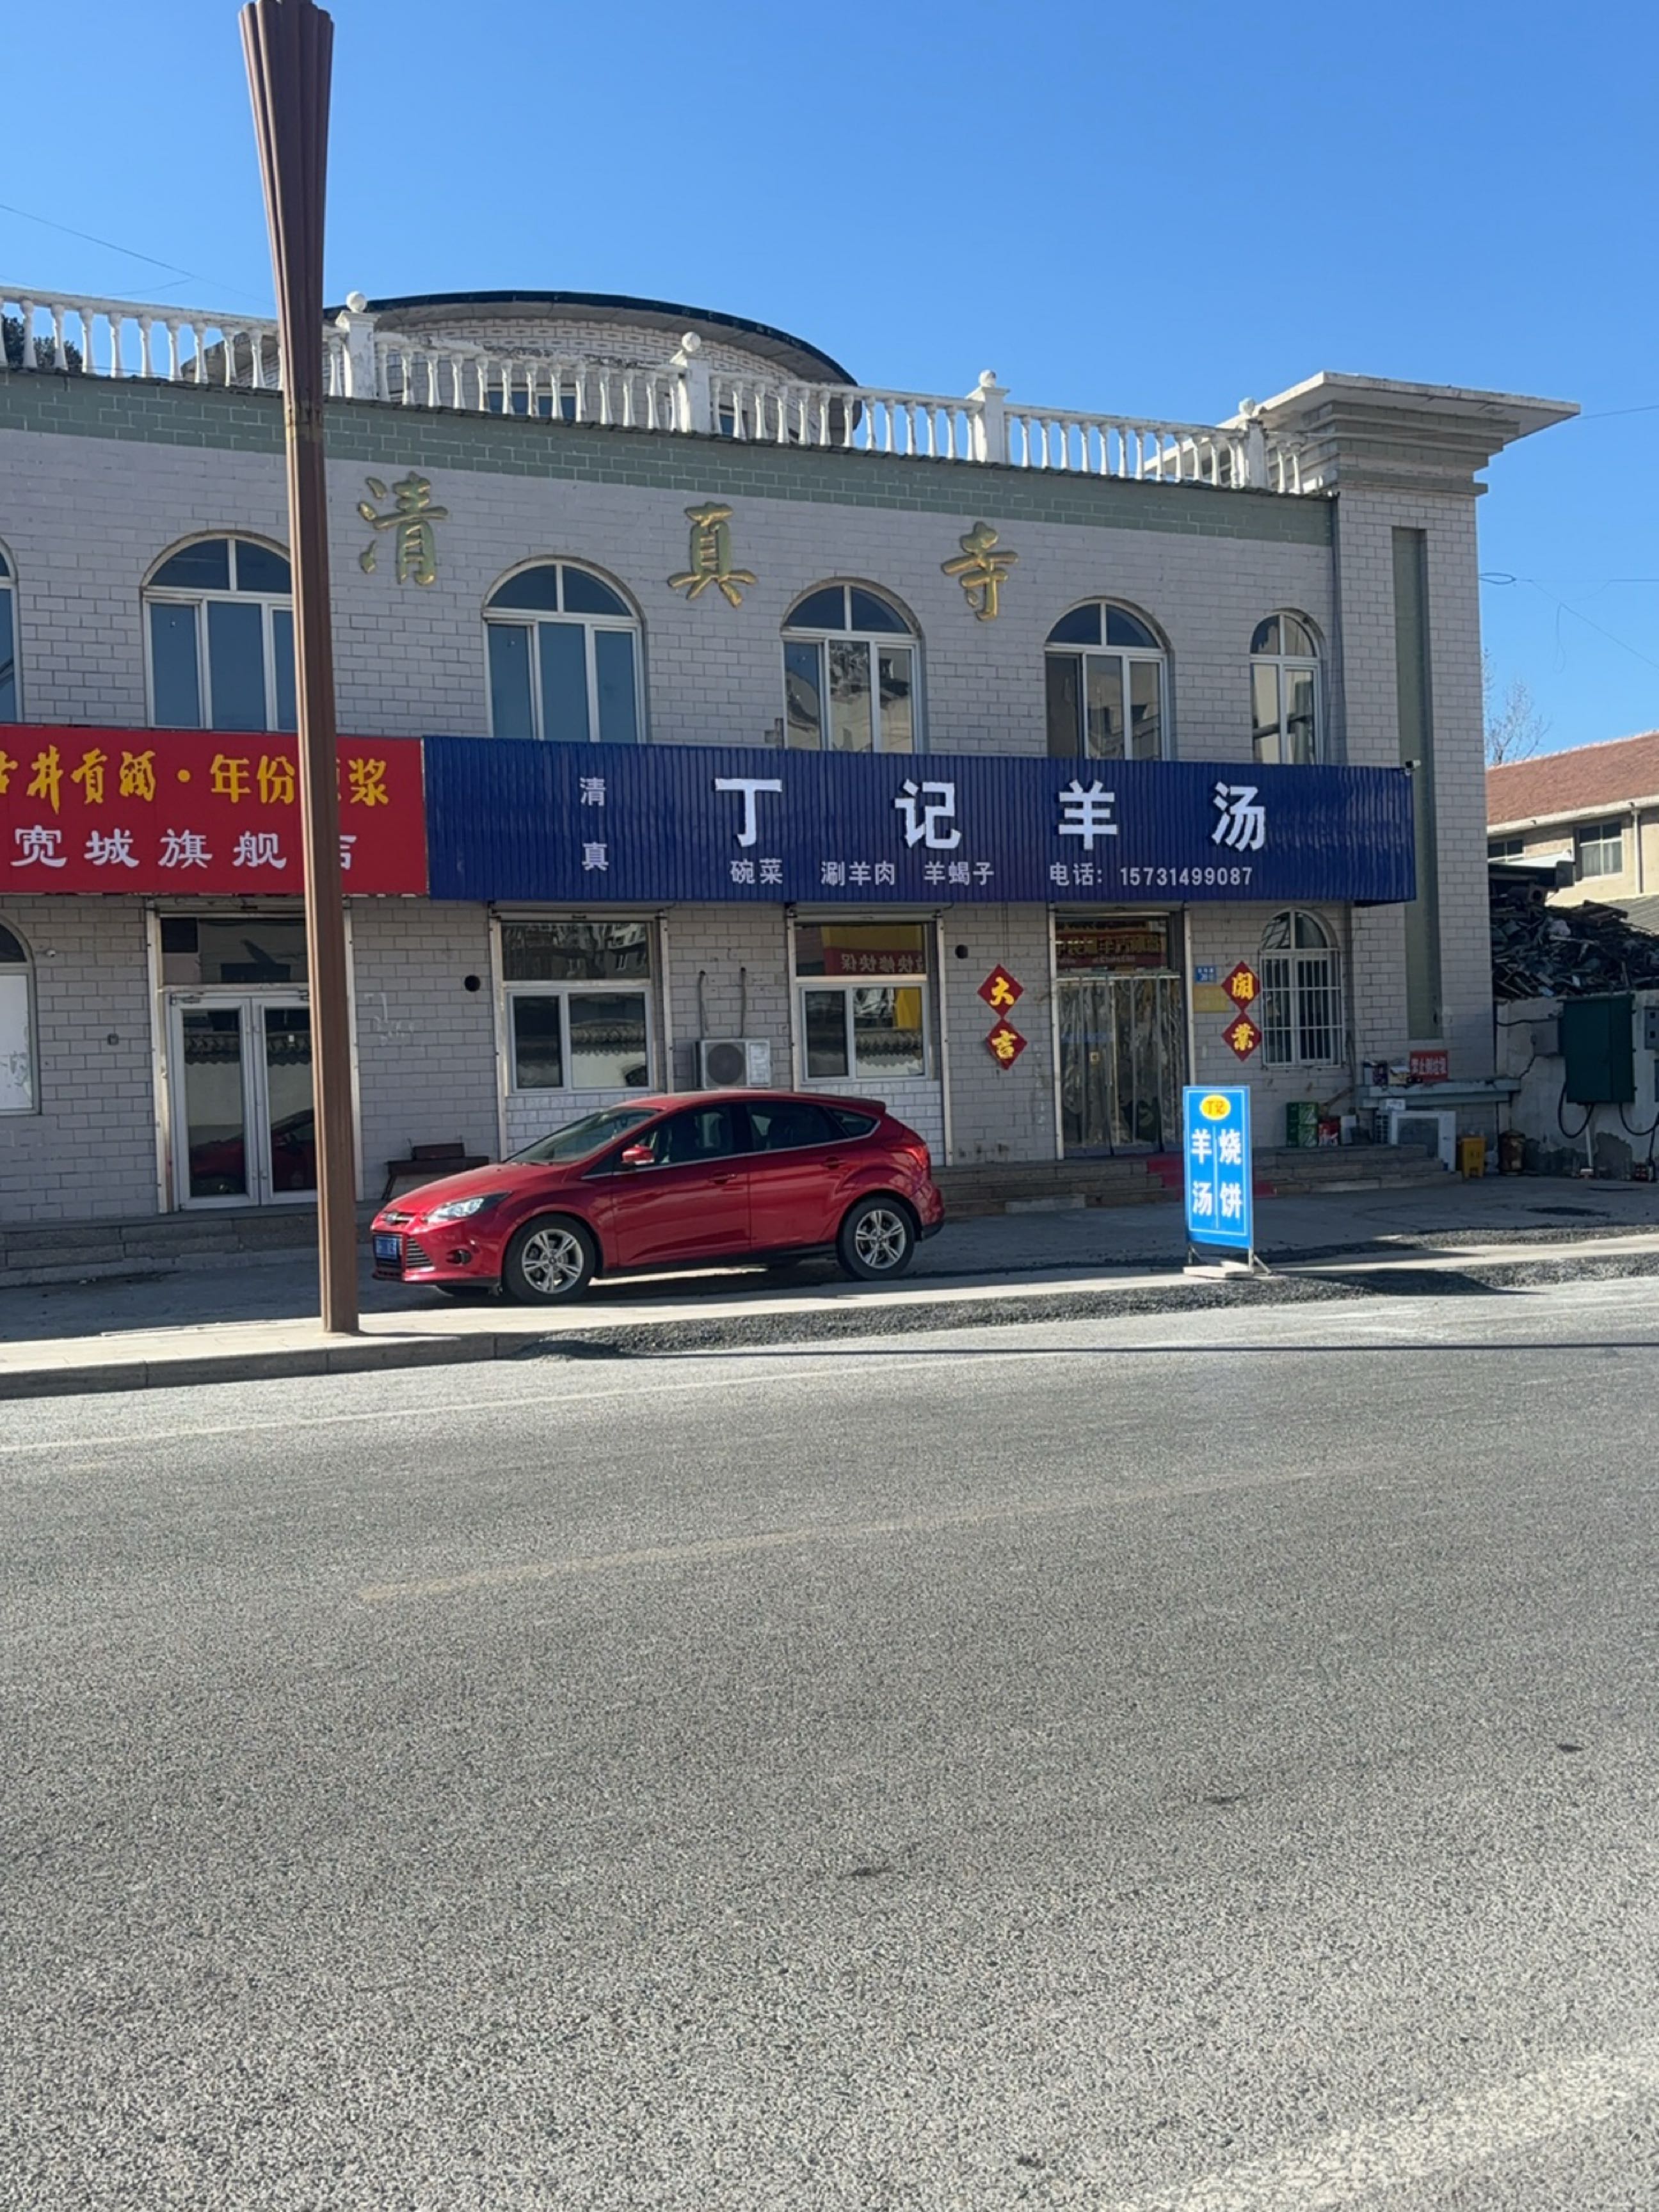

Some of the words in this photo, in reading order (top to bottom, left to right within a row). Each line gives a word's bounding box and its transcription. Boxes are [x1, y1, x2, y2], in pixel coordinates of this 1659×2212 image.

[579, 776, 609, 871] 清真
[714, 778, 1267, 852] 丁记羊汤
[730, 858, 783, 885] 碗菜
[821, 860, 895, 886] 涮羊肉
[924, 860, 995, 886] 羊蝎子
[1120, 867, 1253, 886] 15731499087
[1191, 1128, 1213, 1216] 羊汤
[1219, 1128, 1243, 1219] 烧饼
